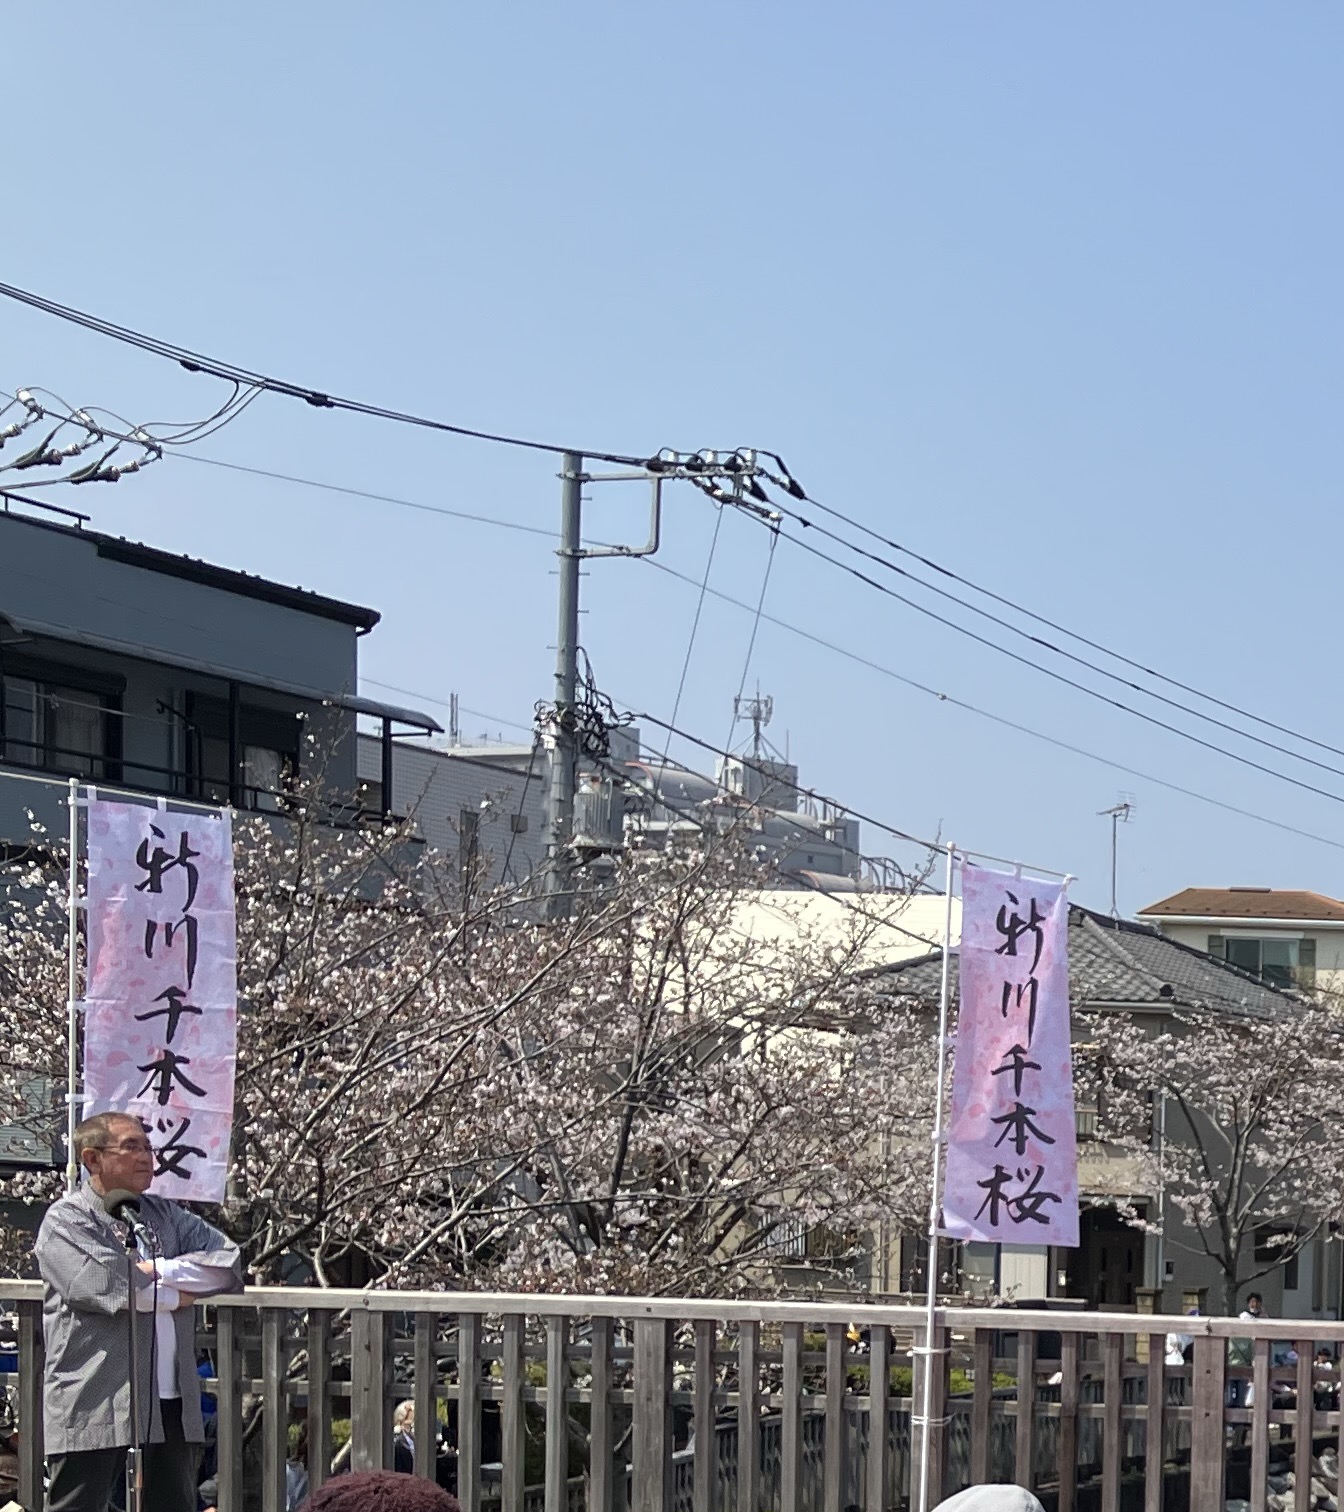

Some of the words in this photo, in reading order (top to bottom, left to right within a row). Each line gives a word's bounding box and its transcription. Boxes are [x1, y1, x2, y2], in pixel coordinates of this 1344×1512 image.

[973, 889, 1062, 1228] 新川千本桜
